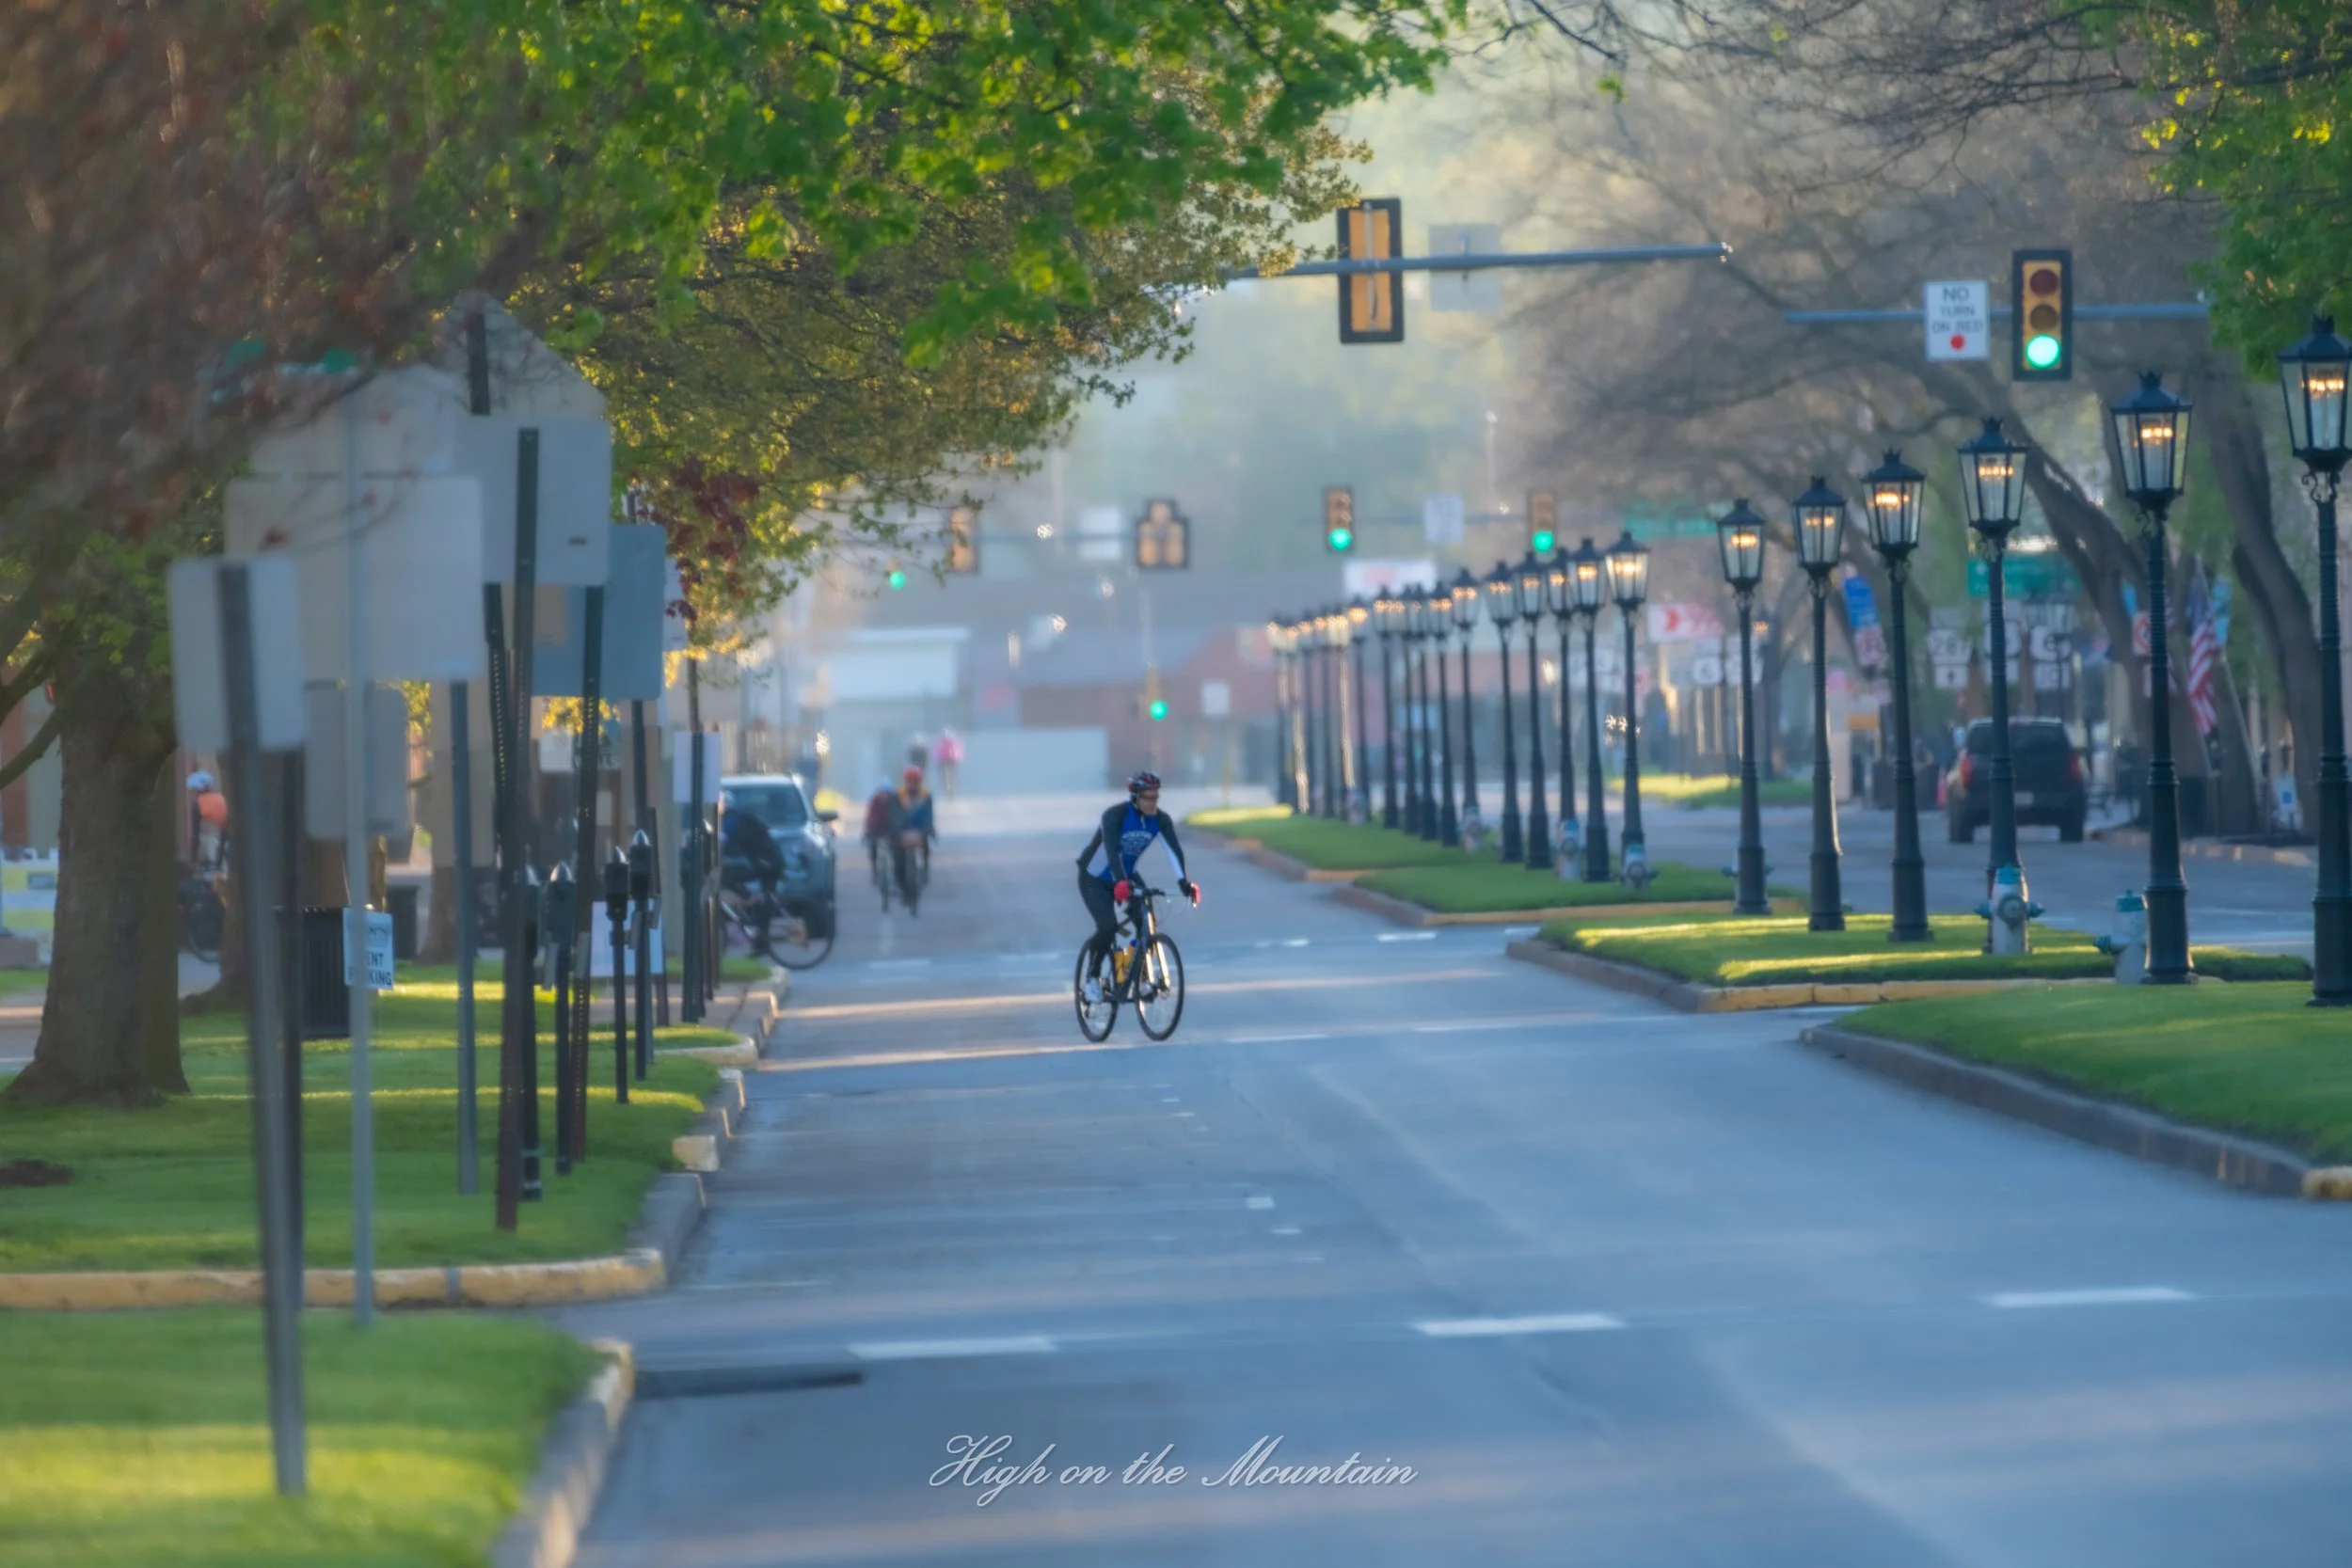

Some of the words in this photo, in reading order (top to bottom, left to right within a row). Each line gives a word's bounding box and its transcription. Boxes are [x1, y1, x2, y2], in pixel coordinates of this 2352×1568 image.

[1943, 287, 1969, 301] NO
[1940, 306, 1975, 317] TURN
[1931, 321, 1950, 333] ON
[1956, 321, 1982, 333] RED
